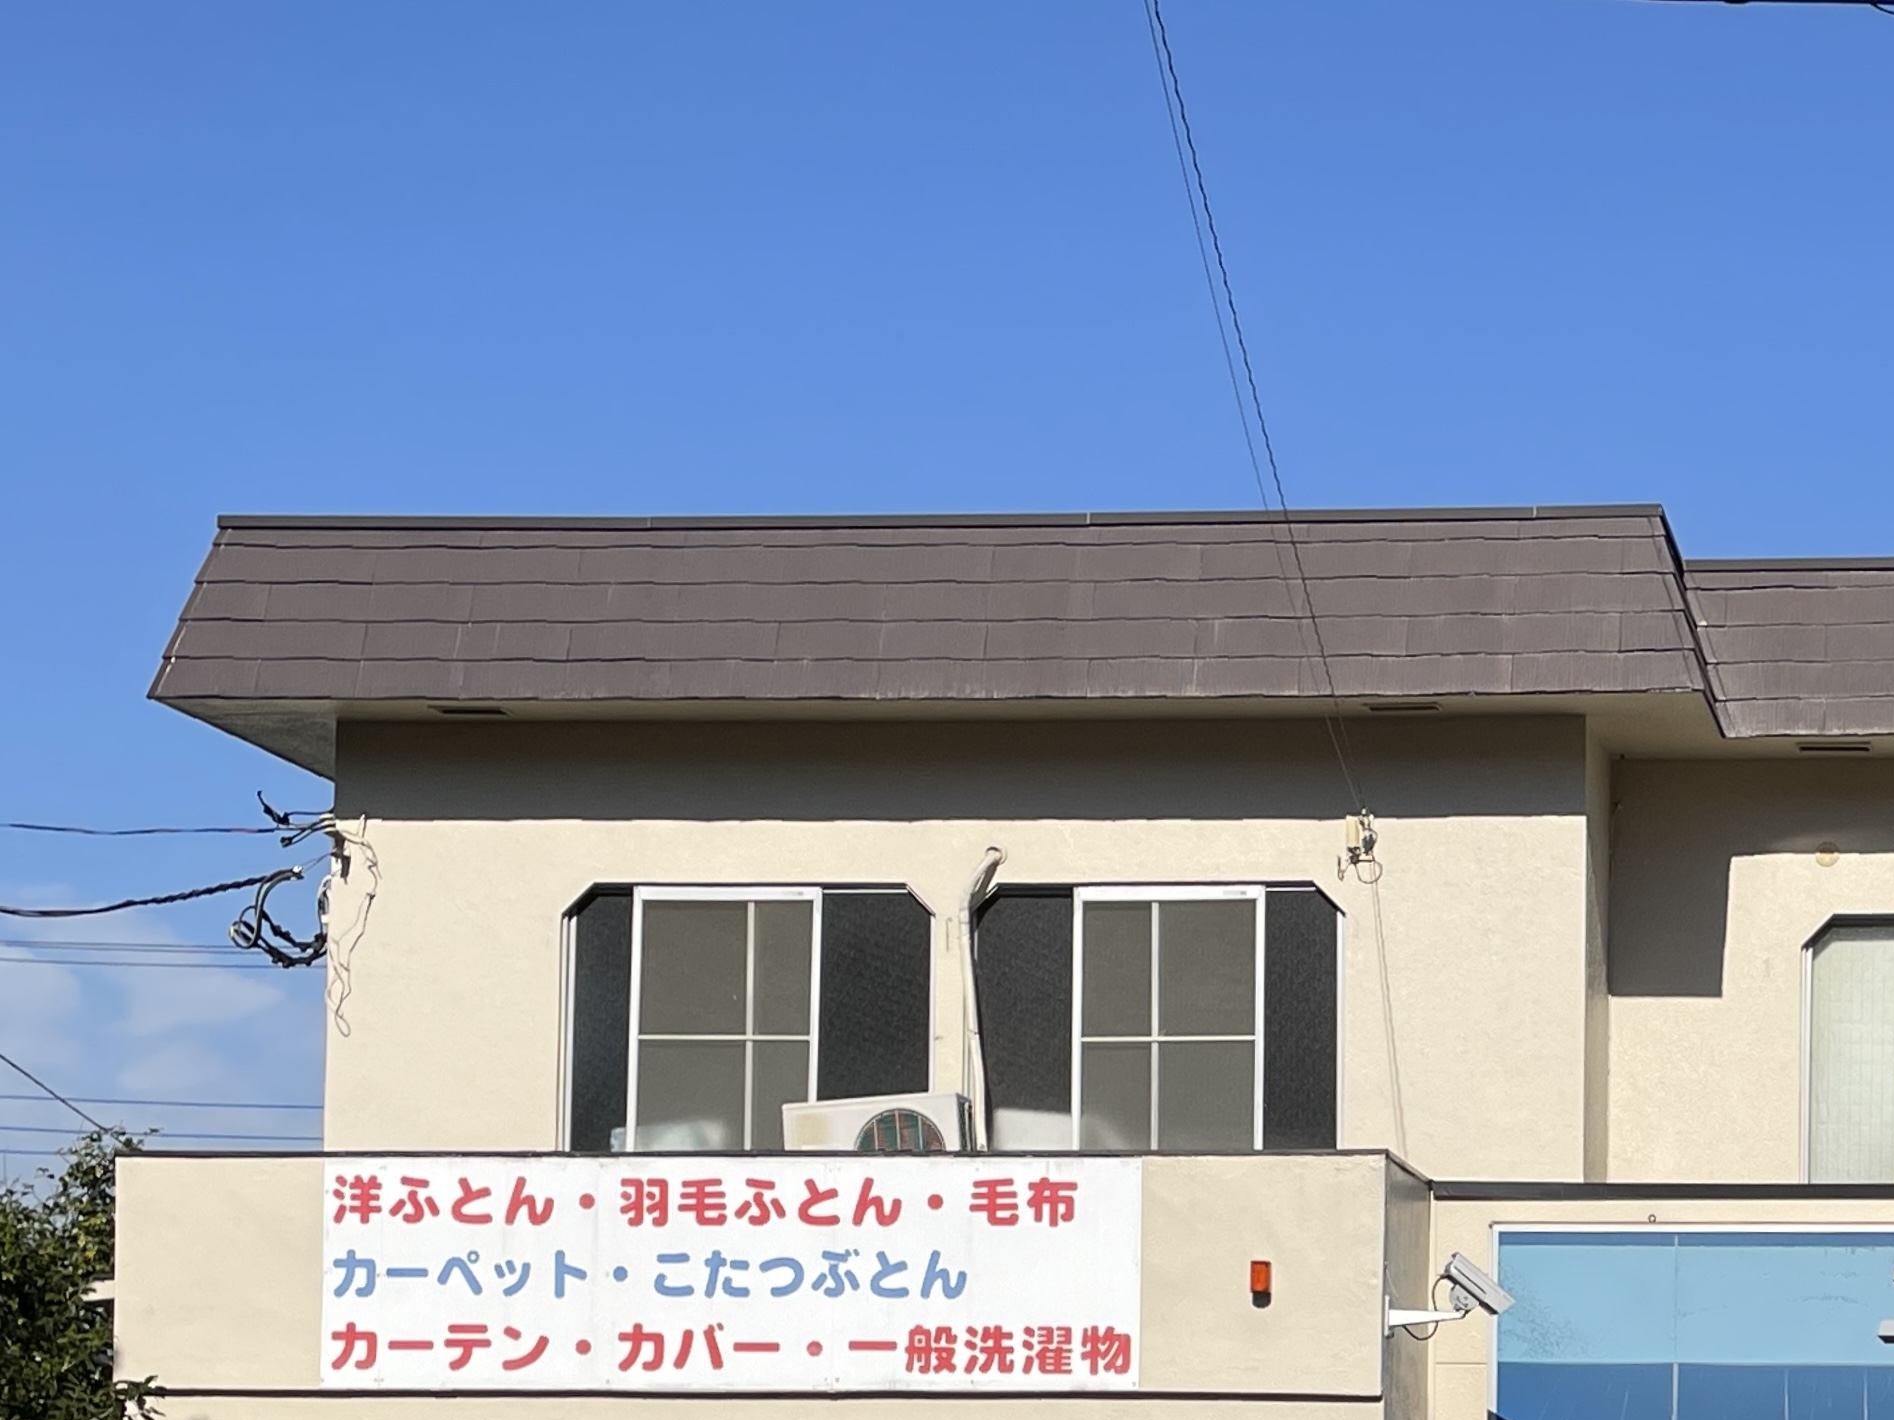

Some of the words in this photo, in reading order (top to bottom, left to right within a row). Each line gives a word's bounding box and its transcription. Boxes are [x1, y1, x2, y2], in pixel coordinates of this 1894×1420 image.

[332, 1175, 1078, 1227] 洋ふとん・羽毛ふとん・毛布
[332, 1250, 968, 1299] カーペット・こたつぶとん
[331, 1323, 1131, 1376] カーテン・カバー・一般洗濯物
